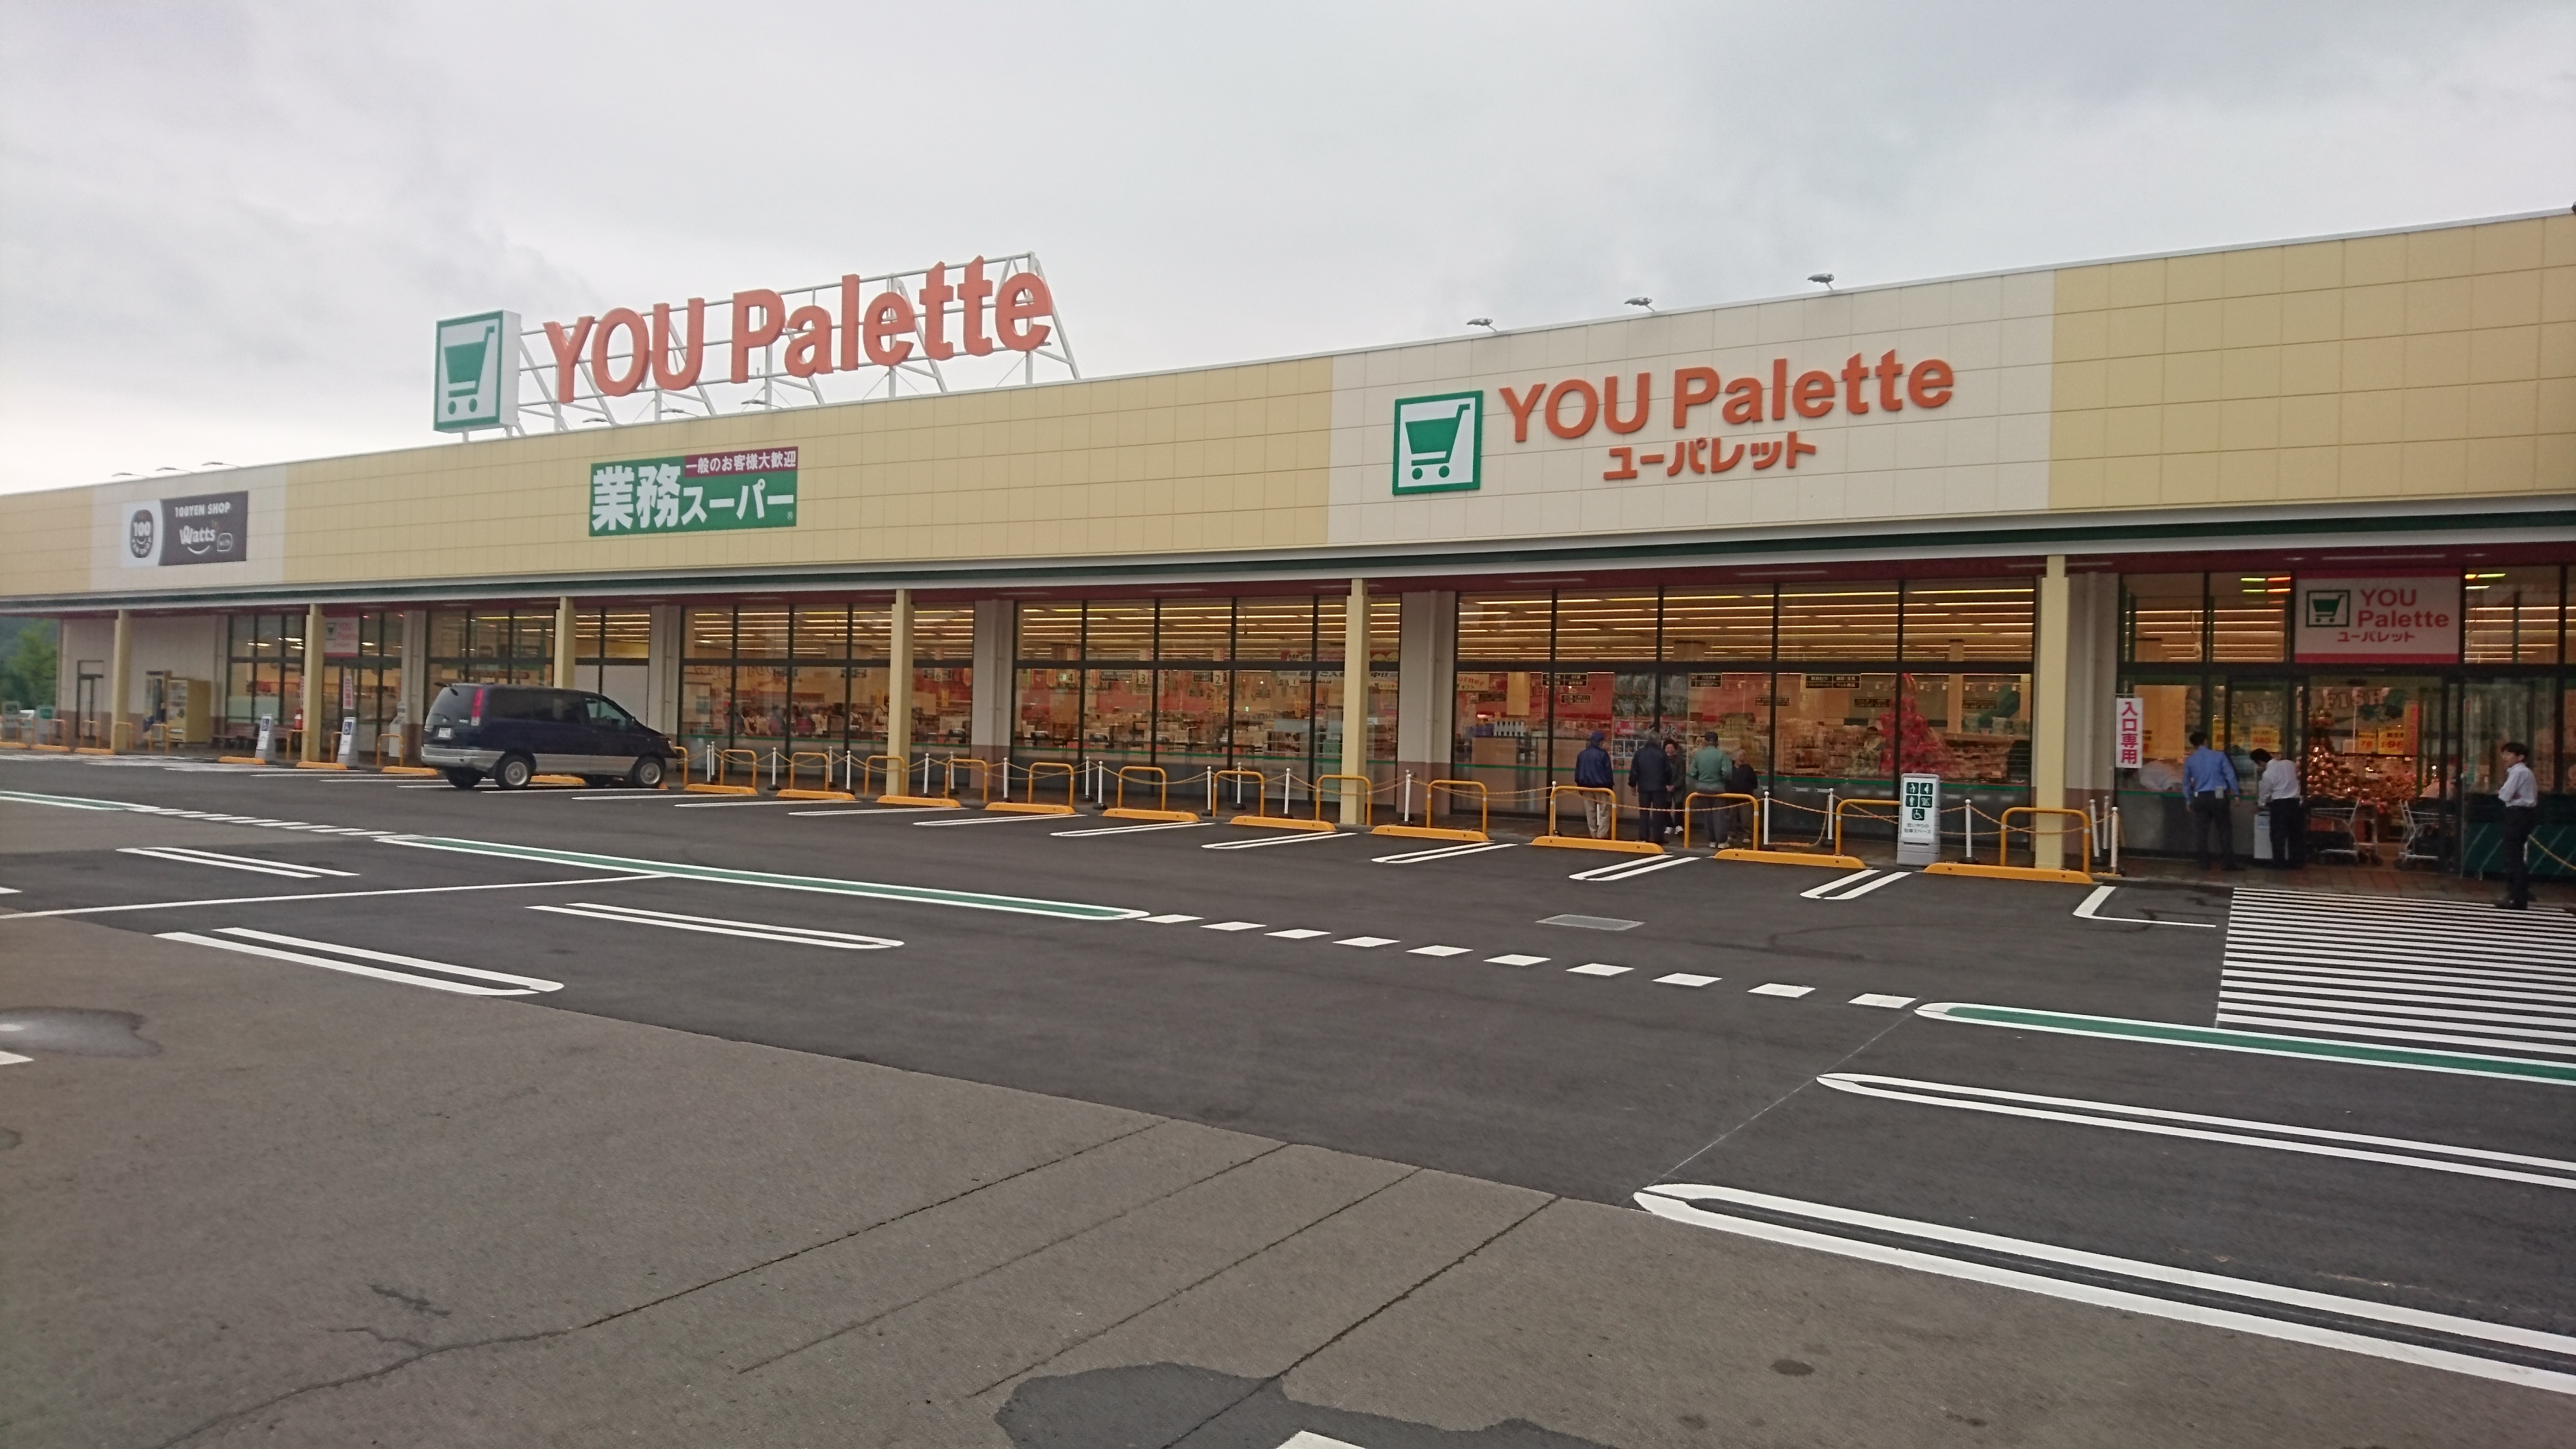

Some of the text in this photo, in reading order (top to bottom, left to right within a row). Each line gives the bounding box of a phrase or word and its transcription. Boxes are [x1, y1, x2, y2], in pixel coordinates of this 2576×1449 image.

[543, 255, 1053, 403] YOU Palette
[1499, 348, 1953, 442] YOU Palette
[686, 450, 796, 474] 一般のお客様大歓迎
[1603, 431, 1816, 480] ユーパレット
[592, 464, 794, 531] 業務スーパー
[208, 502, 231, 514] SHOP
[133, 521, 151, 537] 100
[179, 525, 215, 545] Watts
[2359, 589, 2416, 607] YOU
[2358, 610, 2449, 628] Palette
[2337, 631, 2415, 642] ユーパレット
[1140, 674, 1146, 684] 3
[1215, 675, 1221, 684] 2
[1458, 676, 1485, 686] orner
[2323, 690, 2384, 710] FISH
[2121, 701, 2138, 765] 入口専用
